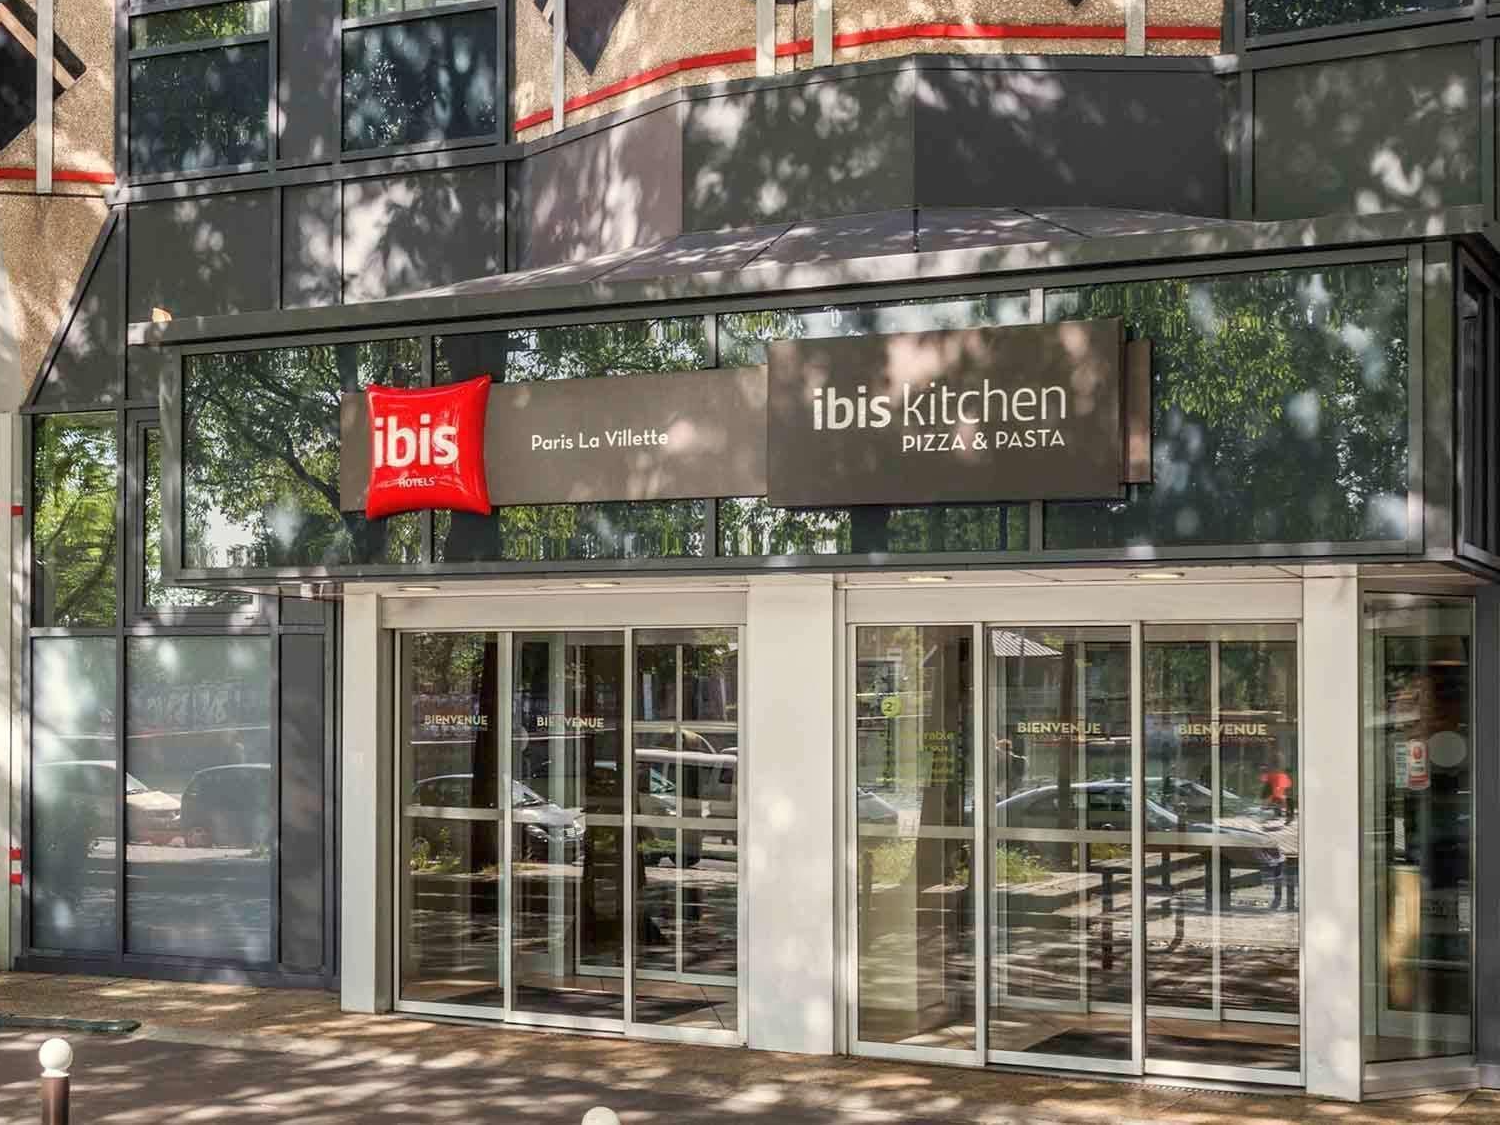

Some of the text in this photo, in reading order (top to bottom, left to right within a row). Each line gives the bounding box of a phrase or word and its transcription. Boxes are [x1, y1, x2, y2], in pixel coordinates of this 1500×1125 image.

[812, 378, 1067, 431] ibis kitchen
[373, 413, 460, 468] ibis
[530, 428, 670, 451] Paris La Villette
[902, 429, 1066, 452] PIZZA & PASTA
[398, 475, 437, 488] HOTELS
[883, 701, 894, 713] 2
[423, 714, 489, 725] BIENVENUE
[536, 716, 605, 728] BIEVENUE
[1017, 721, 1102, 734] BIENVENUE
[1179, 723, 1268, 735] BIENVENUE
